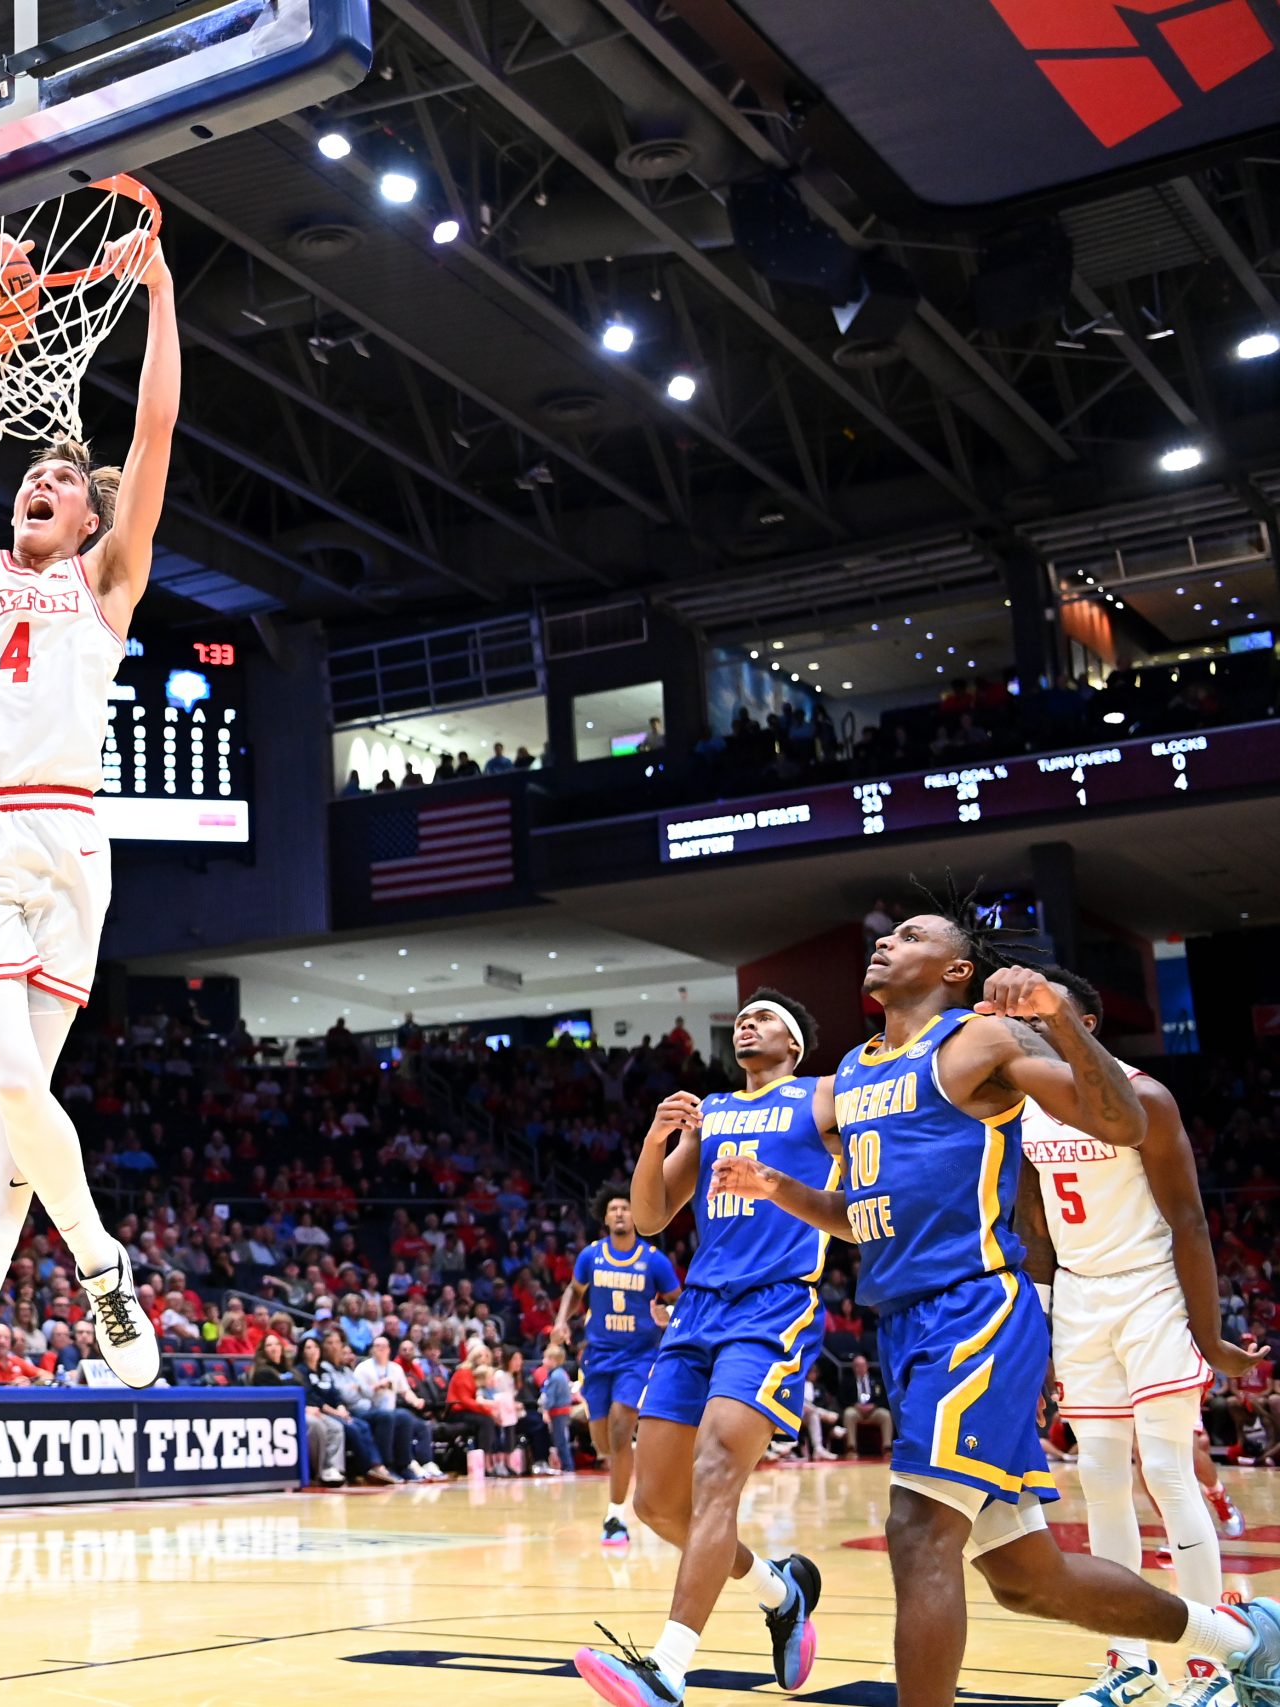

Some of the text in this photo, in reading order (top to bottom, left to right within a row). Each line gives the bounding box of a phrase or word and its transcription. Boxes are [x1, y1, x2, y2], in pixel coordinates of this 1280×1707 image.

[0, 621, 31, 683] 4
[193, 643, 234, 666] 7:33
[133, 706, 146, 721] P
[164, 706, 178, 722] R
[192, 708, 206, 723] A
[1151, 736, 1207, 756] BLOCKS
[1037, 748, 1121, 772] TURN OVERS
[1172, 753, 1186, 770] 0
[924, 771, 959, 789] FIELD
[960, 768, 994, 785] GOAL
[1071, 767, 1084, 783] 4
[1174, 773, 1188, 790] 4
[1076, 788, 1086, 806] 1
[757, 805, 810, 827] STATE
[669, 835, 733, 859] DAYTON
[848, 1130, 881, 1191] 10
[1021, 1139, 1117, 1163] DAYTON
[1053, 1173, 1087, 1224] 5
[847, 1195, 896, 1244] STATE
[594, 1269, 646, 1291] MOREHEAD
[605, 1314, 636, 1332] STATE
[143, 1417, 299, 1473] FLYERS
